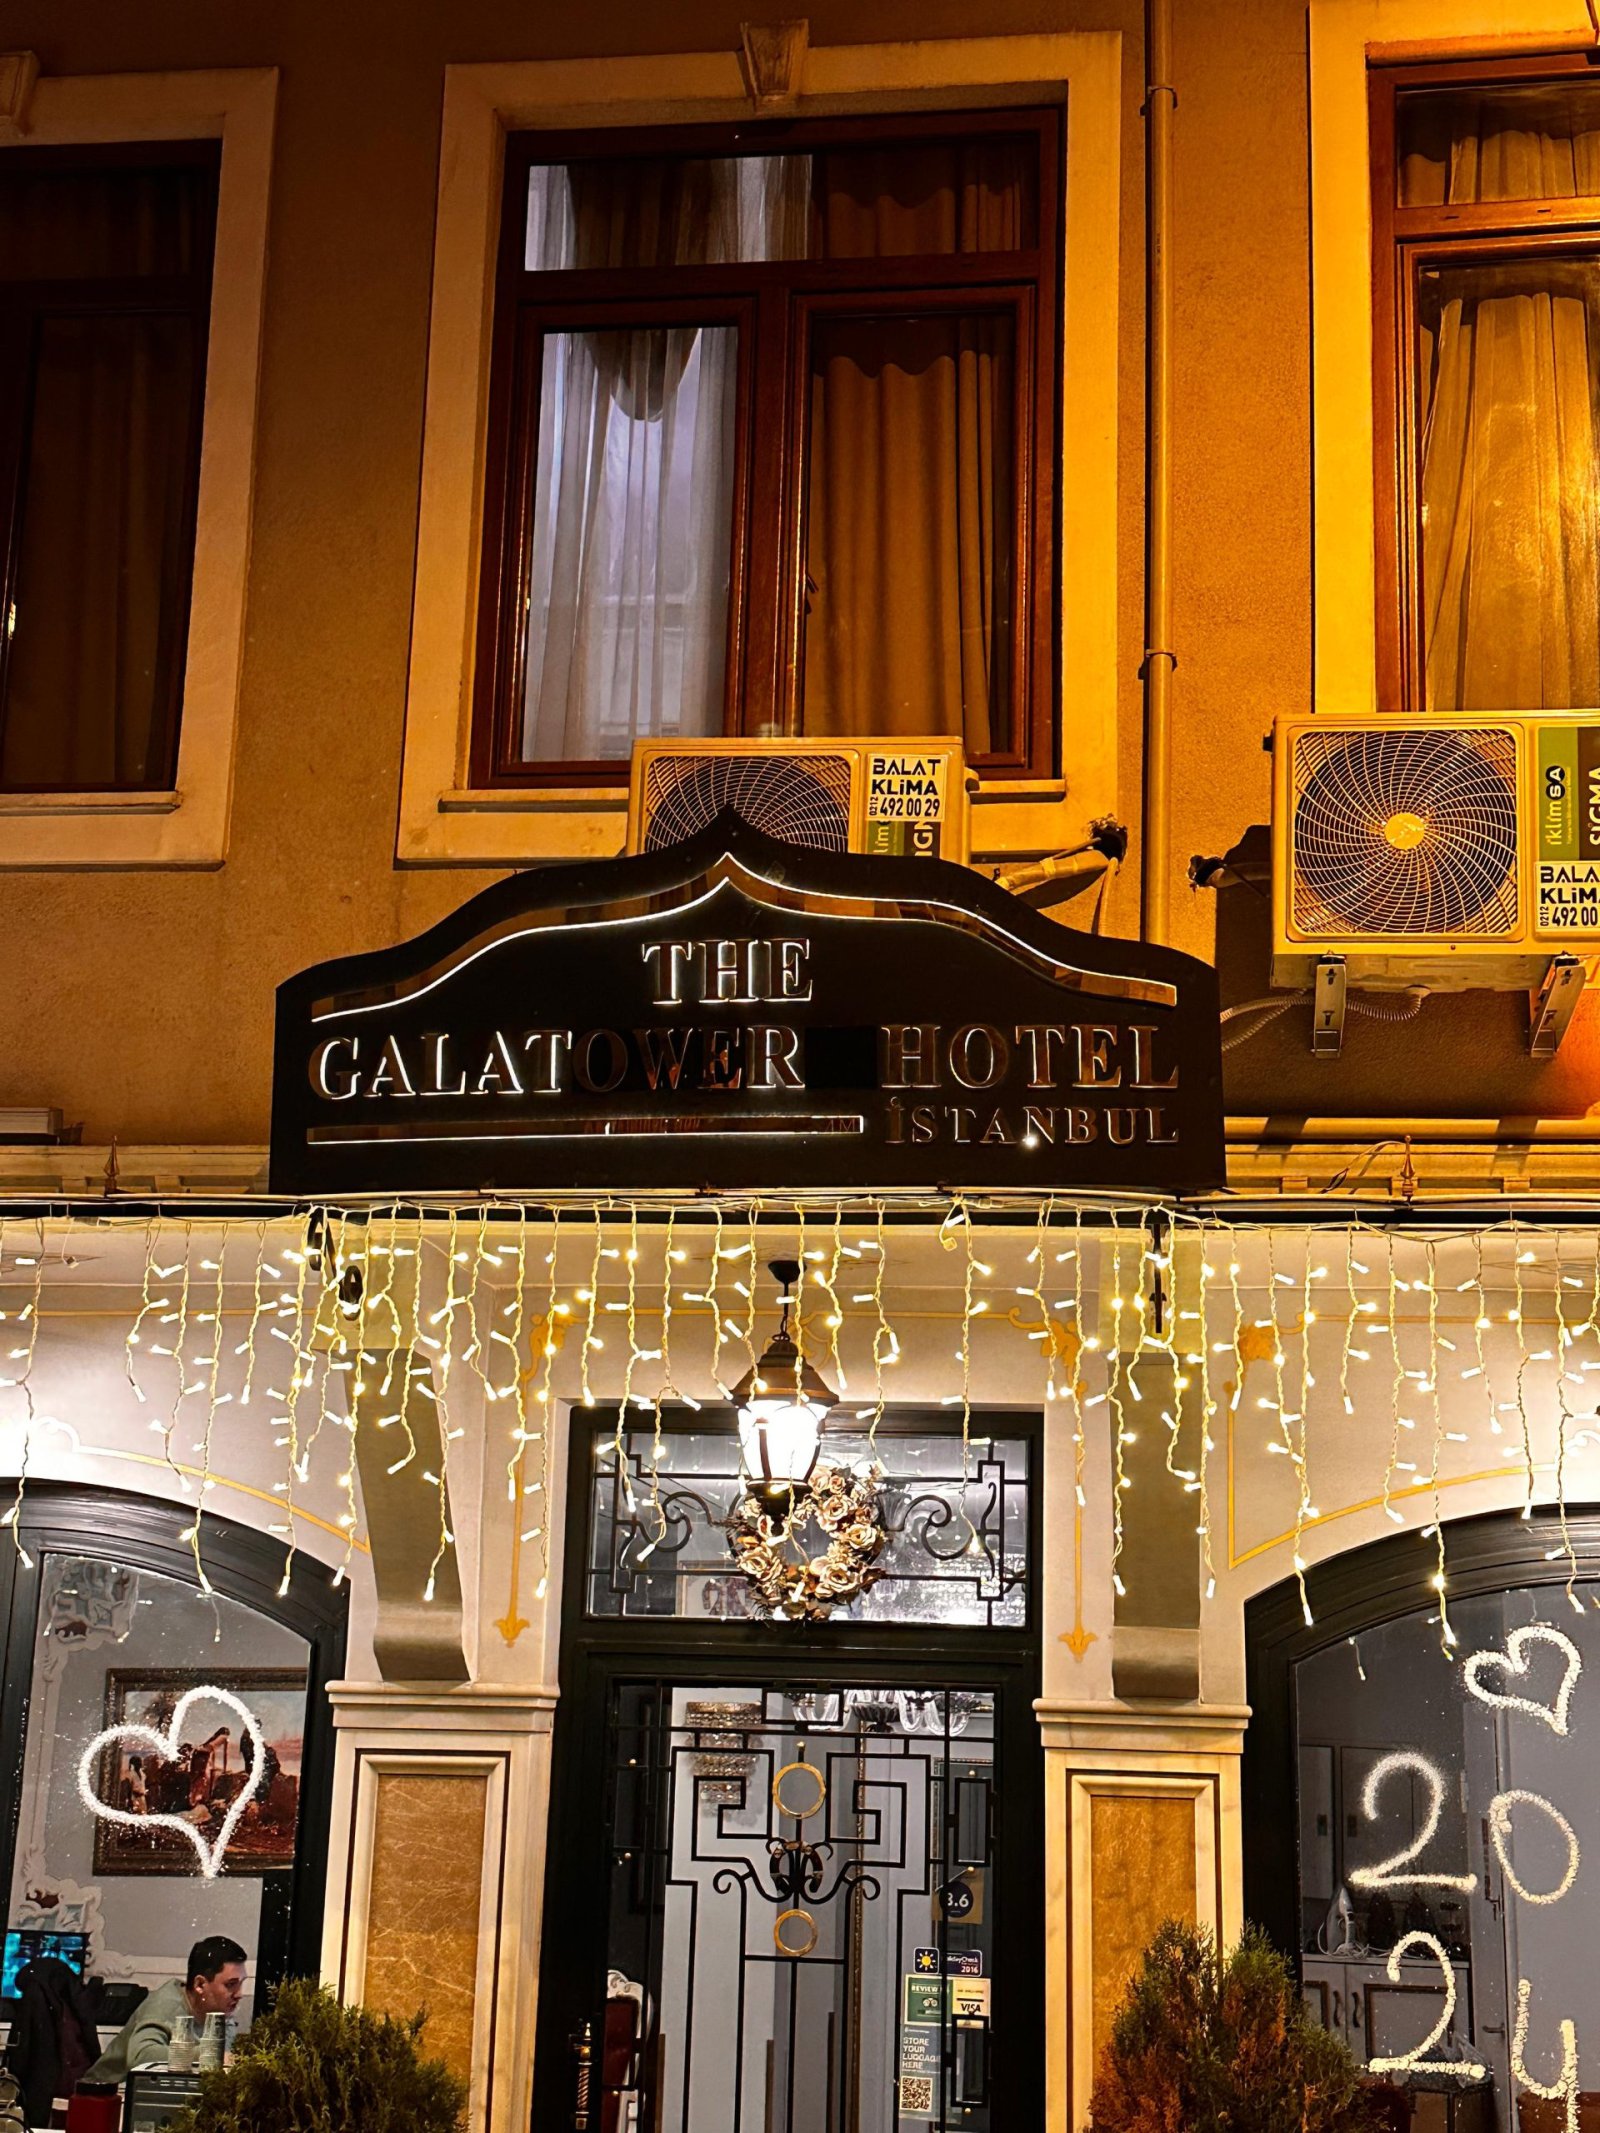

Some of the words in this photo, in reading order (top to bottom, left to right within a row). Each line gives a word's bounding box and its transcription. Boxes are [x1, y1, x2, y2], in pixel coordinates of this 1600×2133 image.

[873, 758, 941, 775] BALAT
[869, 796, 878, 816] 0212
[880, 797, 903, 816] 492
[906, 797, 922, 817] 00
[924, 798, 940, 817] 29
[1540, 887, 1600, 904] KLiM
[1540, 906, 1549, 927] 0212
[1552, 906, 1578, 927] 492
[1581, 906, 1598, 926] 00
[641, 938, 813, 1004] THE
[880, 1023, 1179, 1090] HOTEL
[961, 2003, 982, 2012] VISA
[902, 2045, 926, 2054] YOUR
[903, 2036, 930, 2046] STORE
[902, 2061, 924, 2070] HERE
